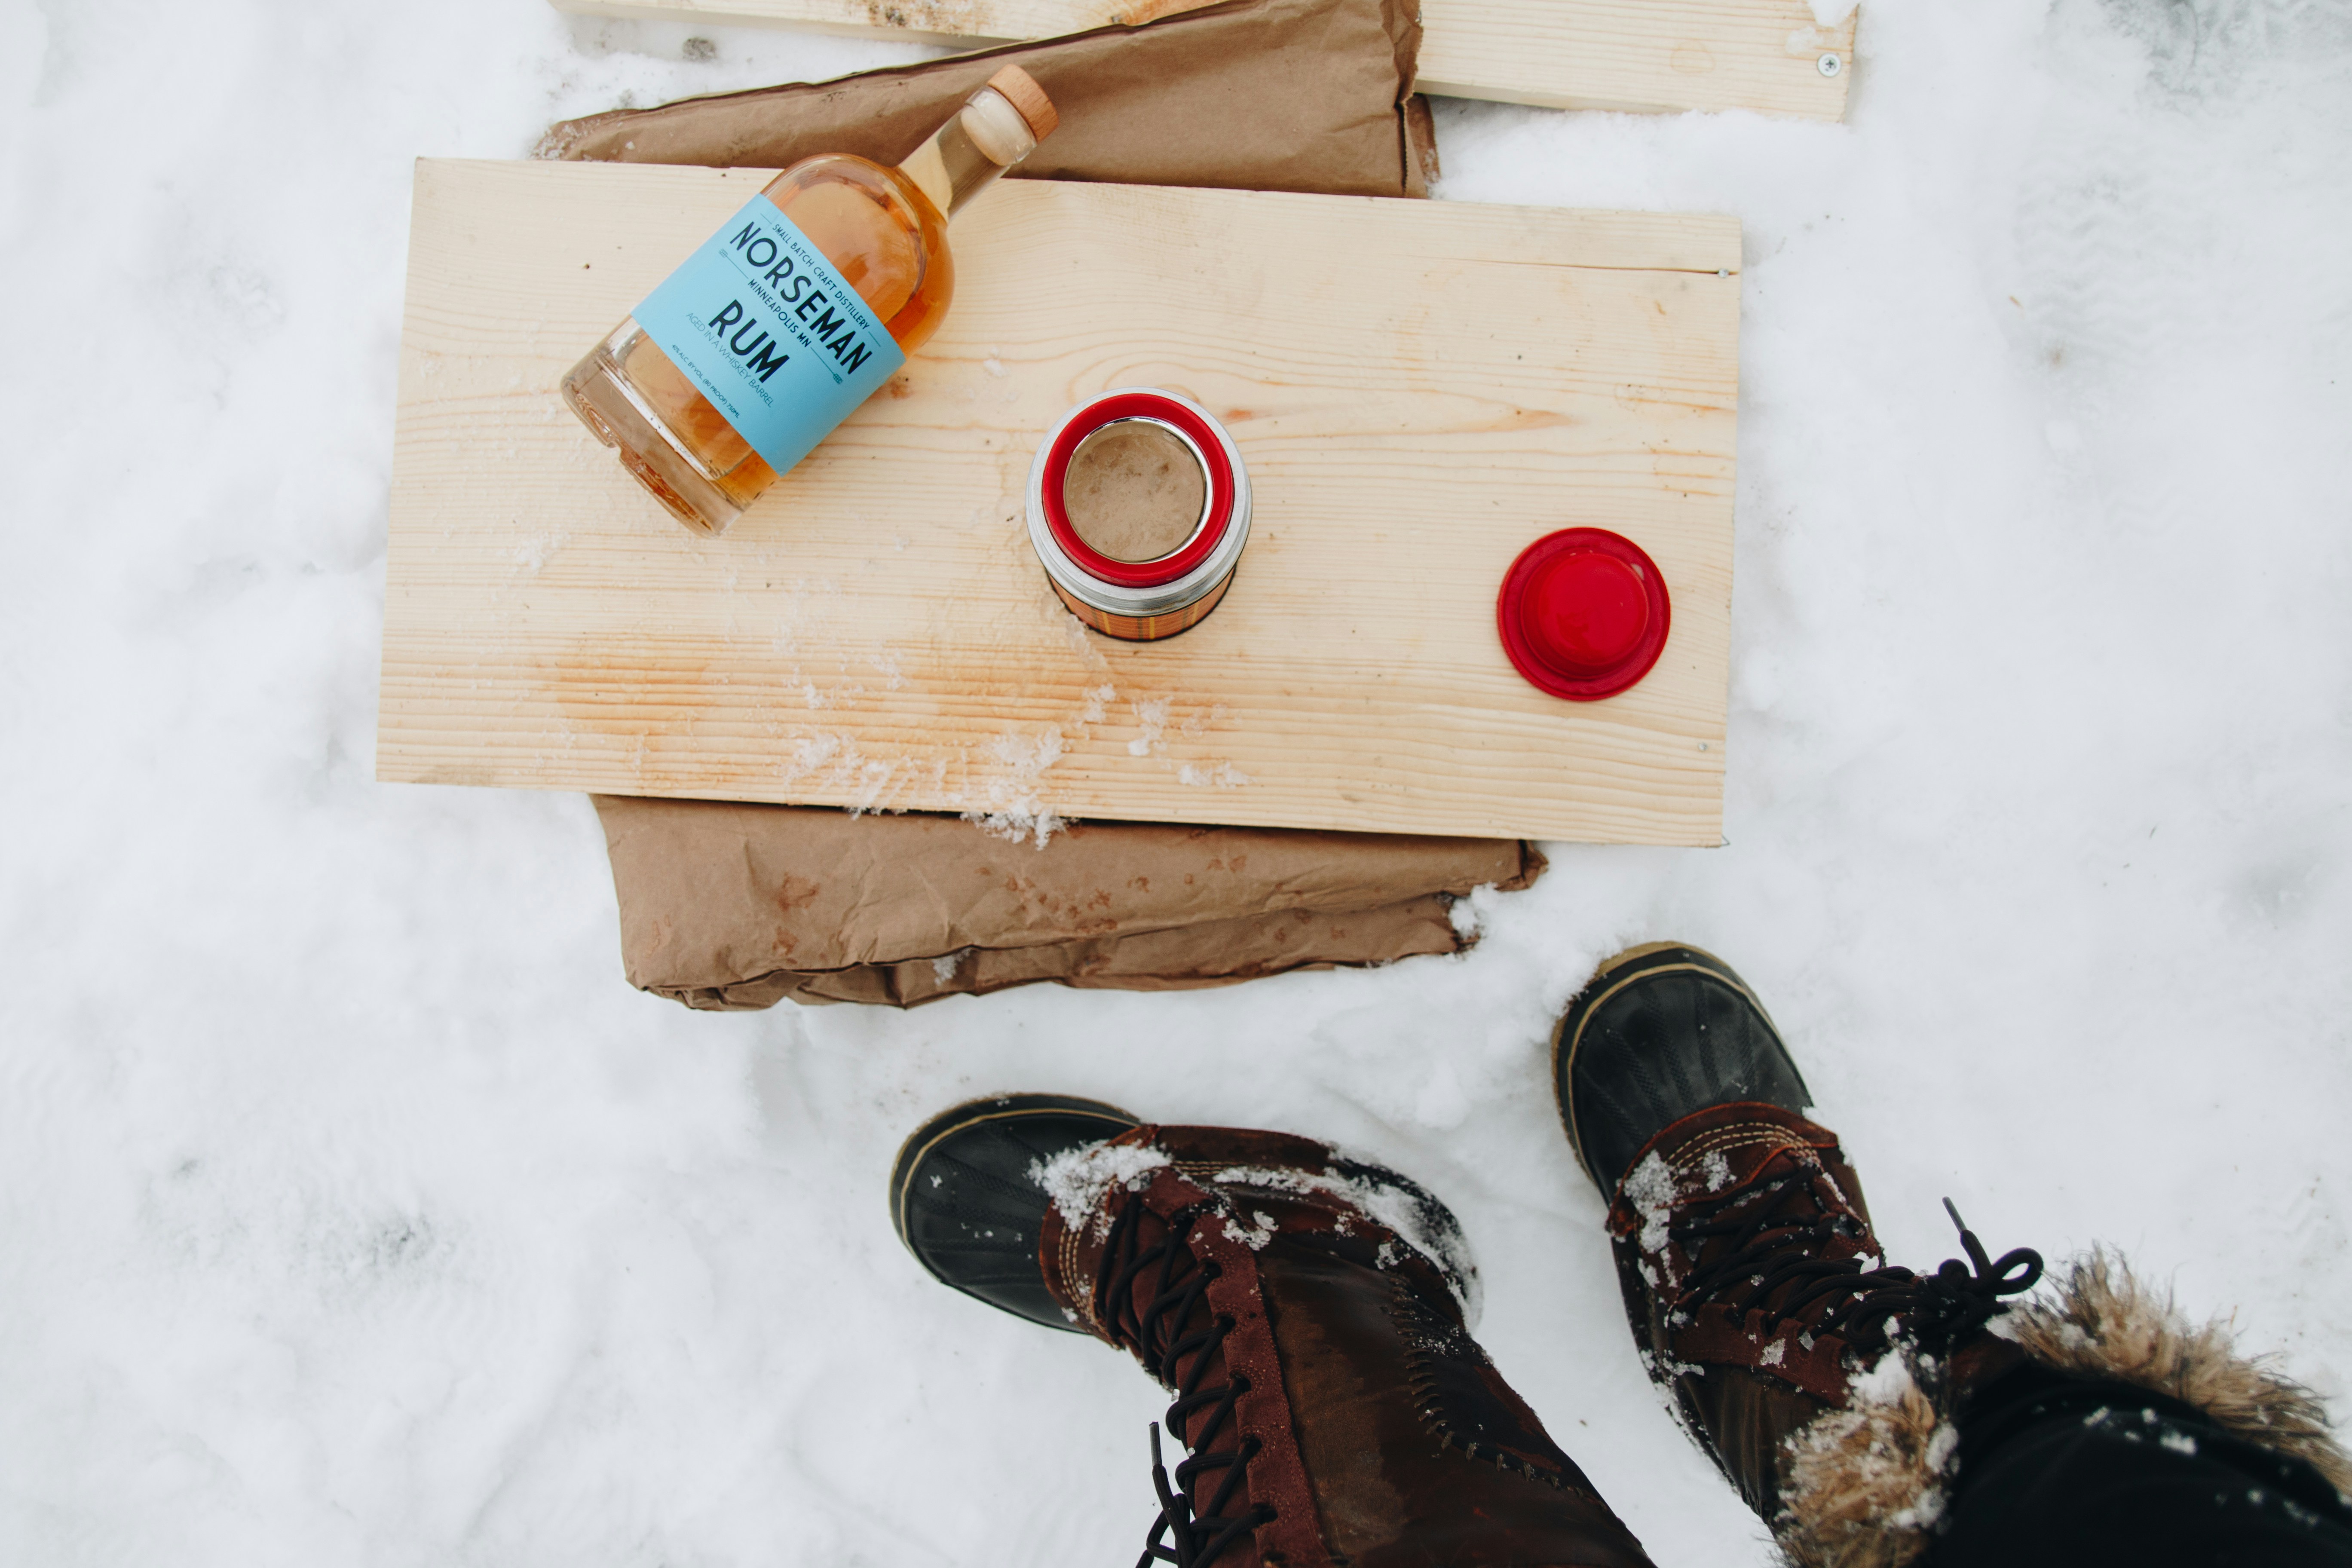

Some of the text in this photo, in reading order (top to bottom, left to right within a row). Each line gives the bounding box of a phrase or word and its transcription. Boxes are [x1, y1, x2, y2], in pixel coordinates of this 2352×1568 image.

[730, 221, 873, 376] NORSEMAN
[748, 279, 812, 347] MINNEAPOLIS MN
[772, 224, 870, 329] SMALL BATCH CRAFT DISTILLERY
[672, 344, 680, 353] 40%
[710, 386, 727, 405] PROOF)
[726, 403, 740, 419] 750ML
[686, 312, 705, 331] AGED
[704, 330, 714, 341] IN
[719, 345, 751, 379] WHISKEY
[748, 379, 774, 408] BARREL
[708, 299, 790, 383] RUM
